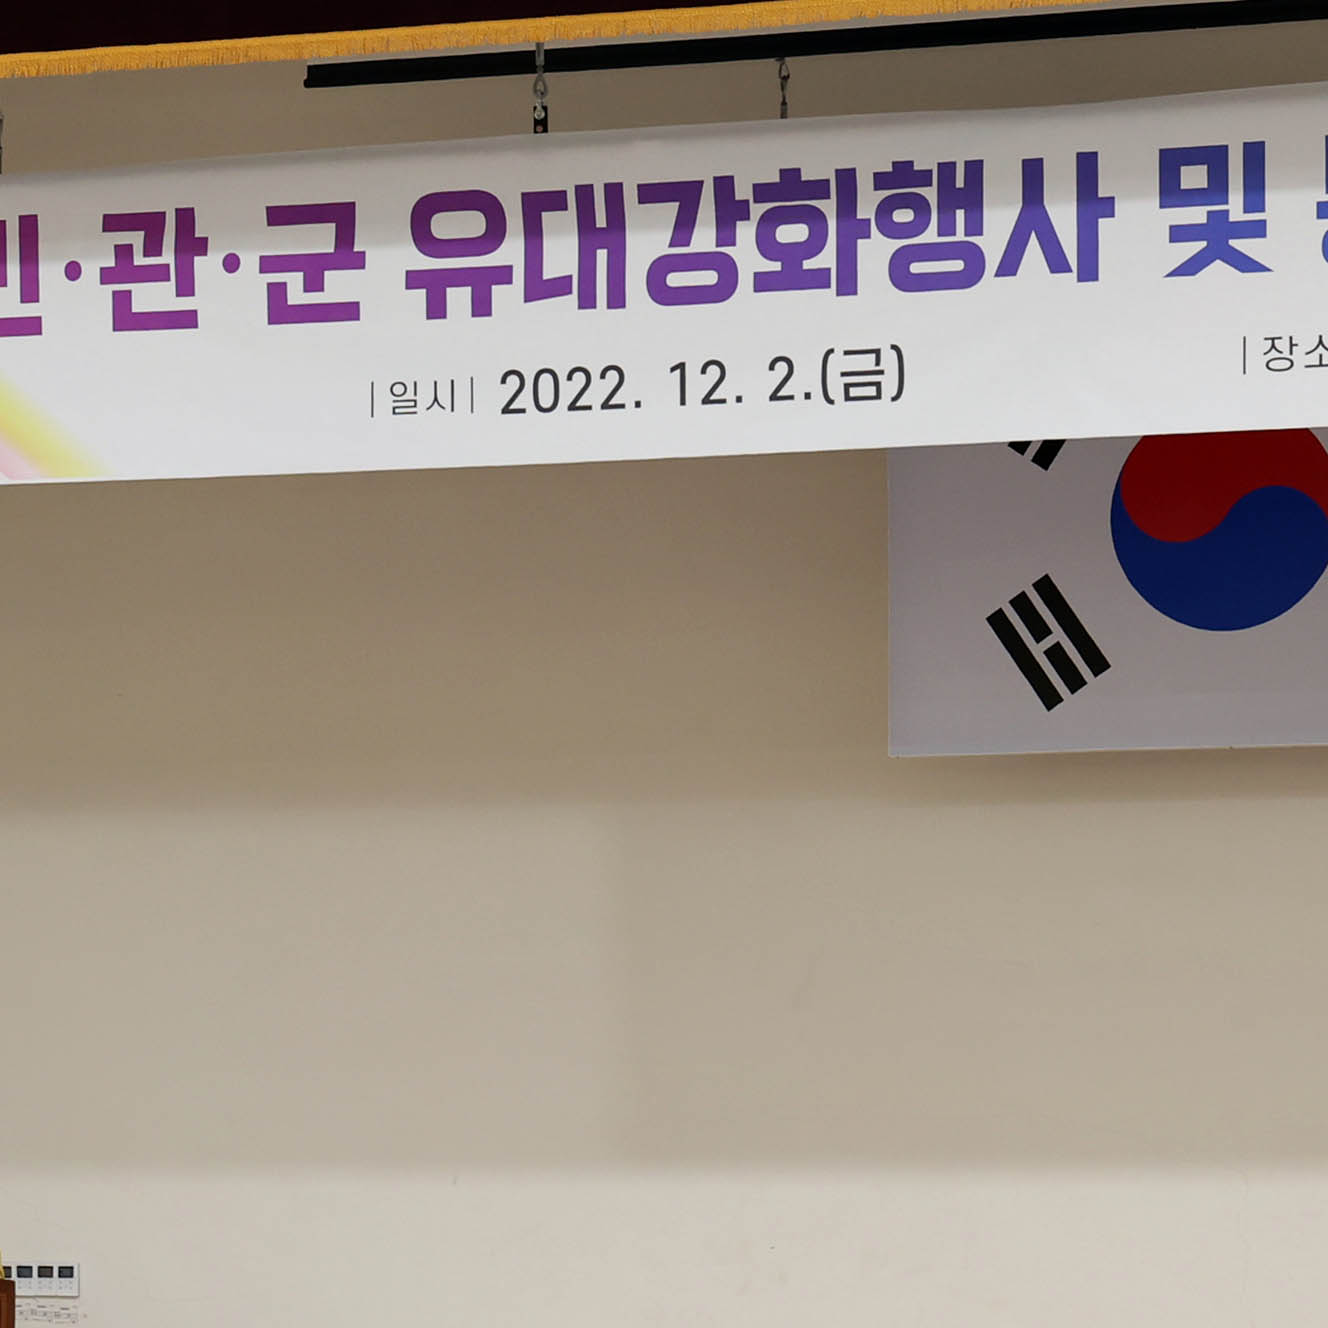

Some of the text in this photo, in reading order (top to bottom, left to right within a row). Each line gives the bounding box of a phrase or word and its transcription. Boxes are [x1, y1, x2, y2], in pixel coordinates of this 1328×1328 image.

[404, 149, 1116, 321] 유대강화행사
[1158, 139, 1274, 282] 및
[500, 363, 643, 415] 2022.
[669, 358, 744, 407] 12.
[768, 342, 906, 406] 2.(금)
